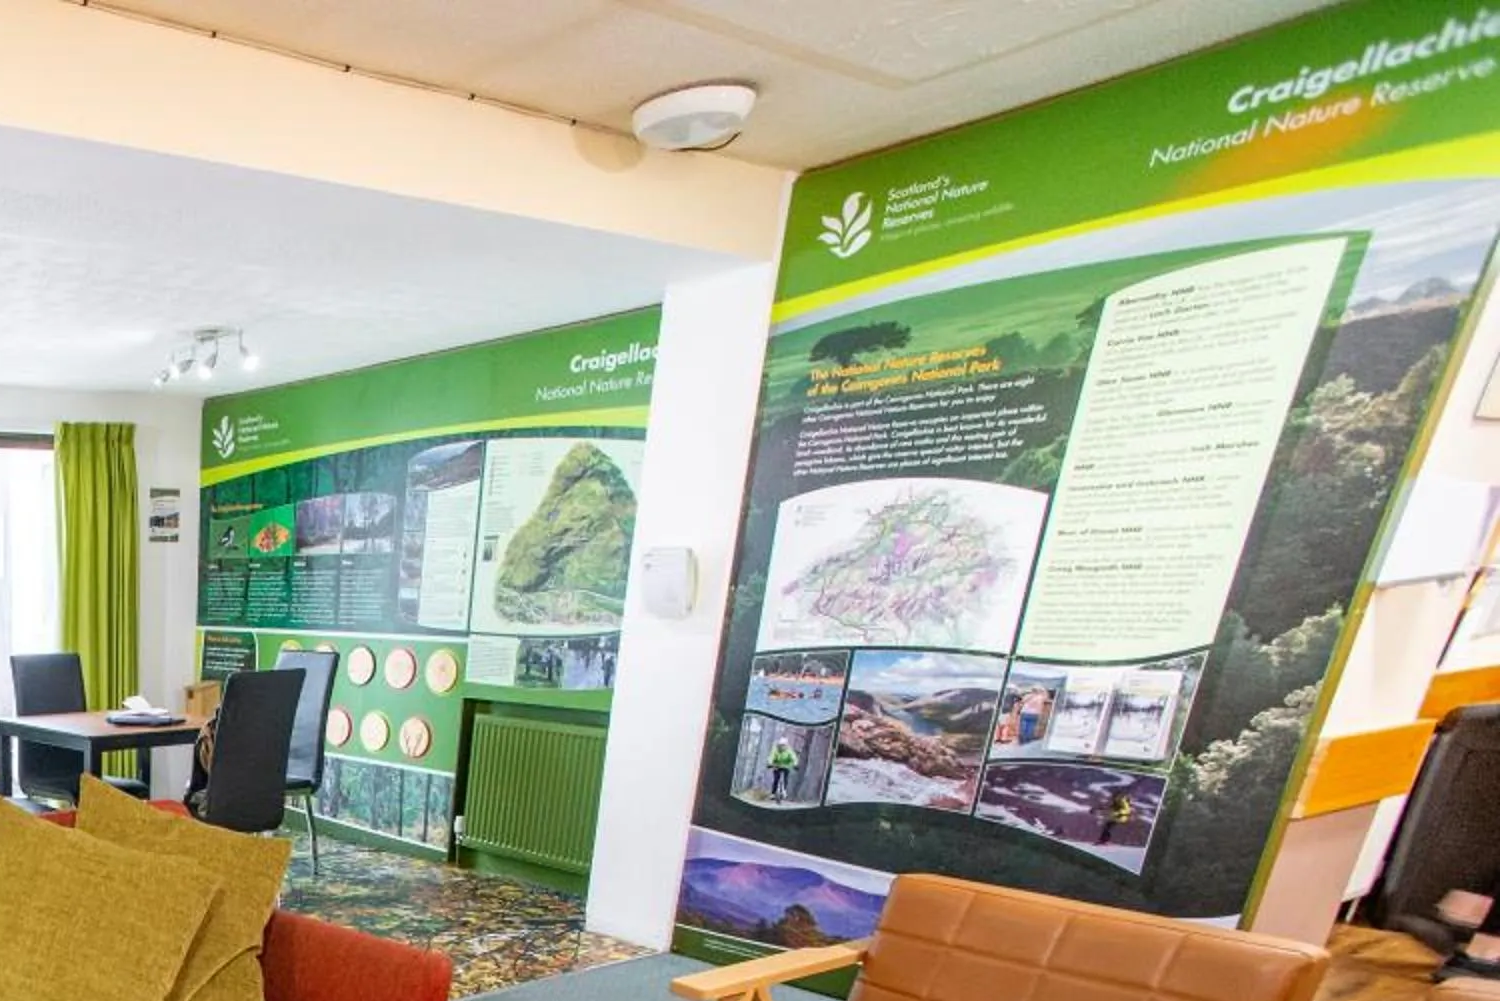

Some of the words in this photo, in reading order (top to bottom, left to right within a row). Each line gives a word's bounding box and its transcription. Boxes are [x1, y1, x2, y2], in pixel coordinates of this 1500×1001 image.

[1149, 120, 1258, 168] National
[1263, 96, 1362, 138] Nature
[1369, 57, 1498, 108] Reserve
[884, 190, 939, 215] National
[941, 180, 989, 201] Nature
[887, 175, 950, 201] Scotland's
[912, 363, 968, 383] National
[969, 359, 1002, 375] Park
[535, 379, 587, 402] National
[589, 377, 633, 395] Nature
